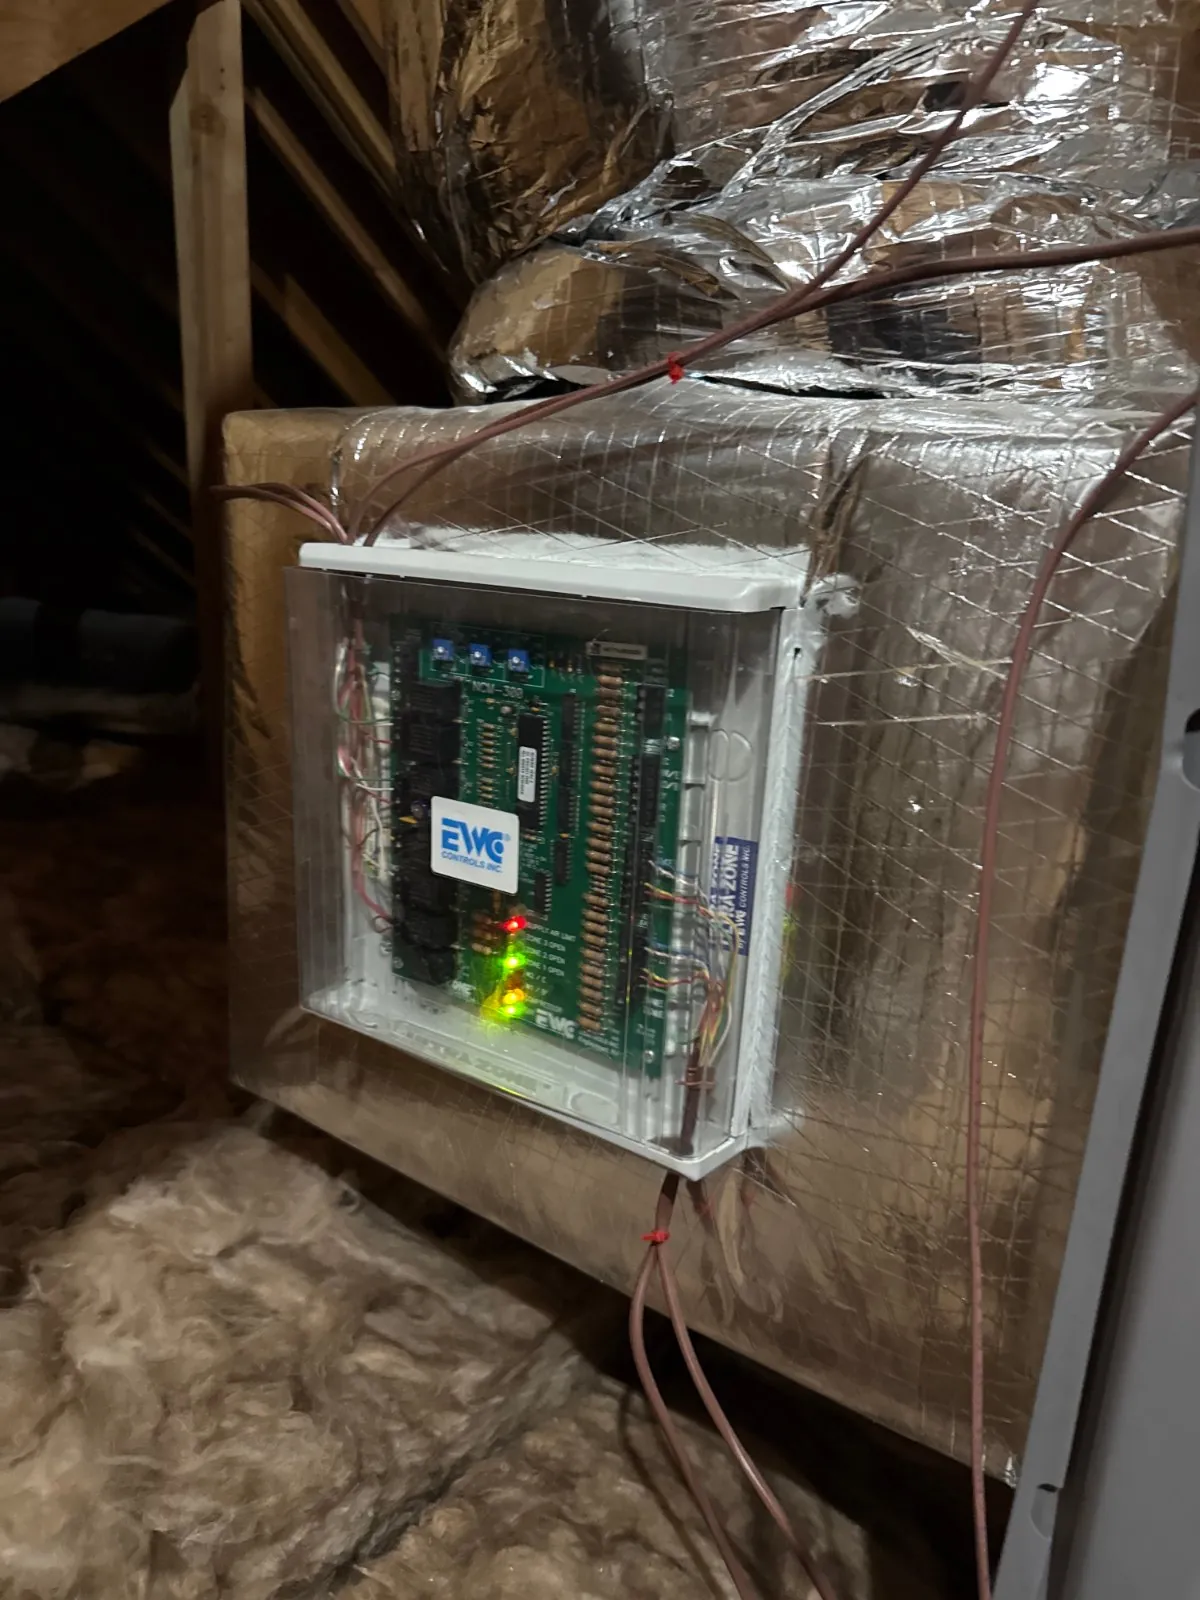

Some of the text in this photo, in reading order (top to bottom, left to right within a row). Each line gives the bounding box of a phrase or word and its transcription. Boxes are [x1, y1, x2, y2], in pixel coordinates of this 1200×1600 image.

[441, 851, 485, 869] CONTROLS
[722, 844, 740, 891] ZONE
[549, 941, 566, 952] OPEN
[548, 953, 566, 964] OPEN
[548, 966, 565, 976] OPEN
